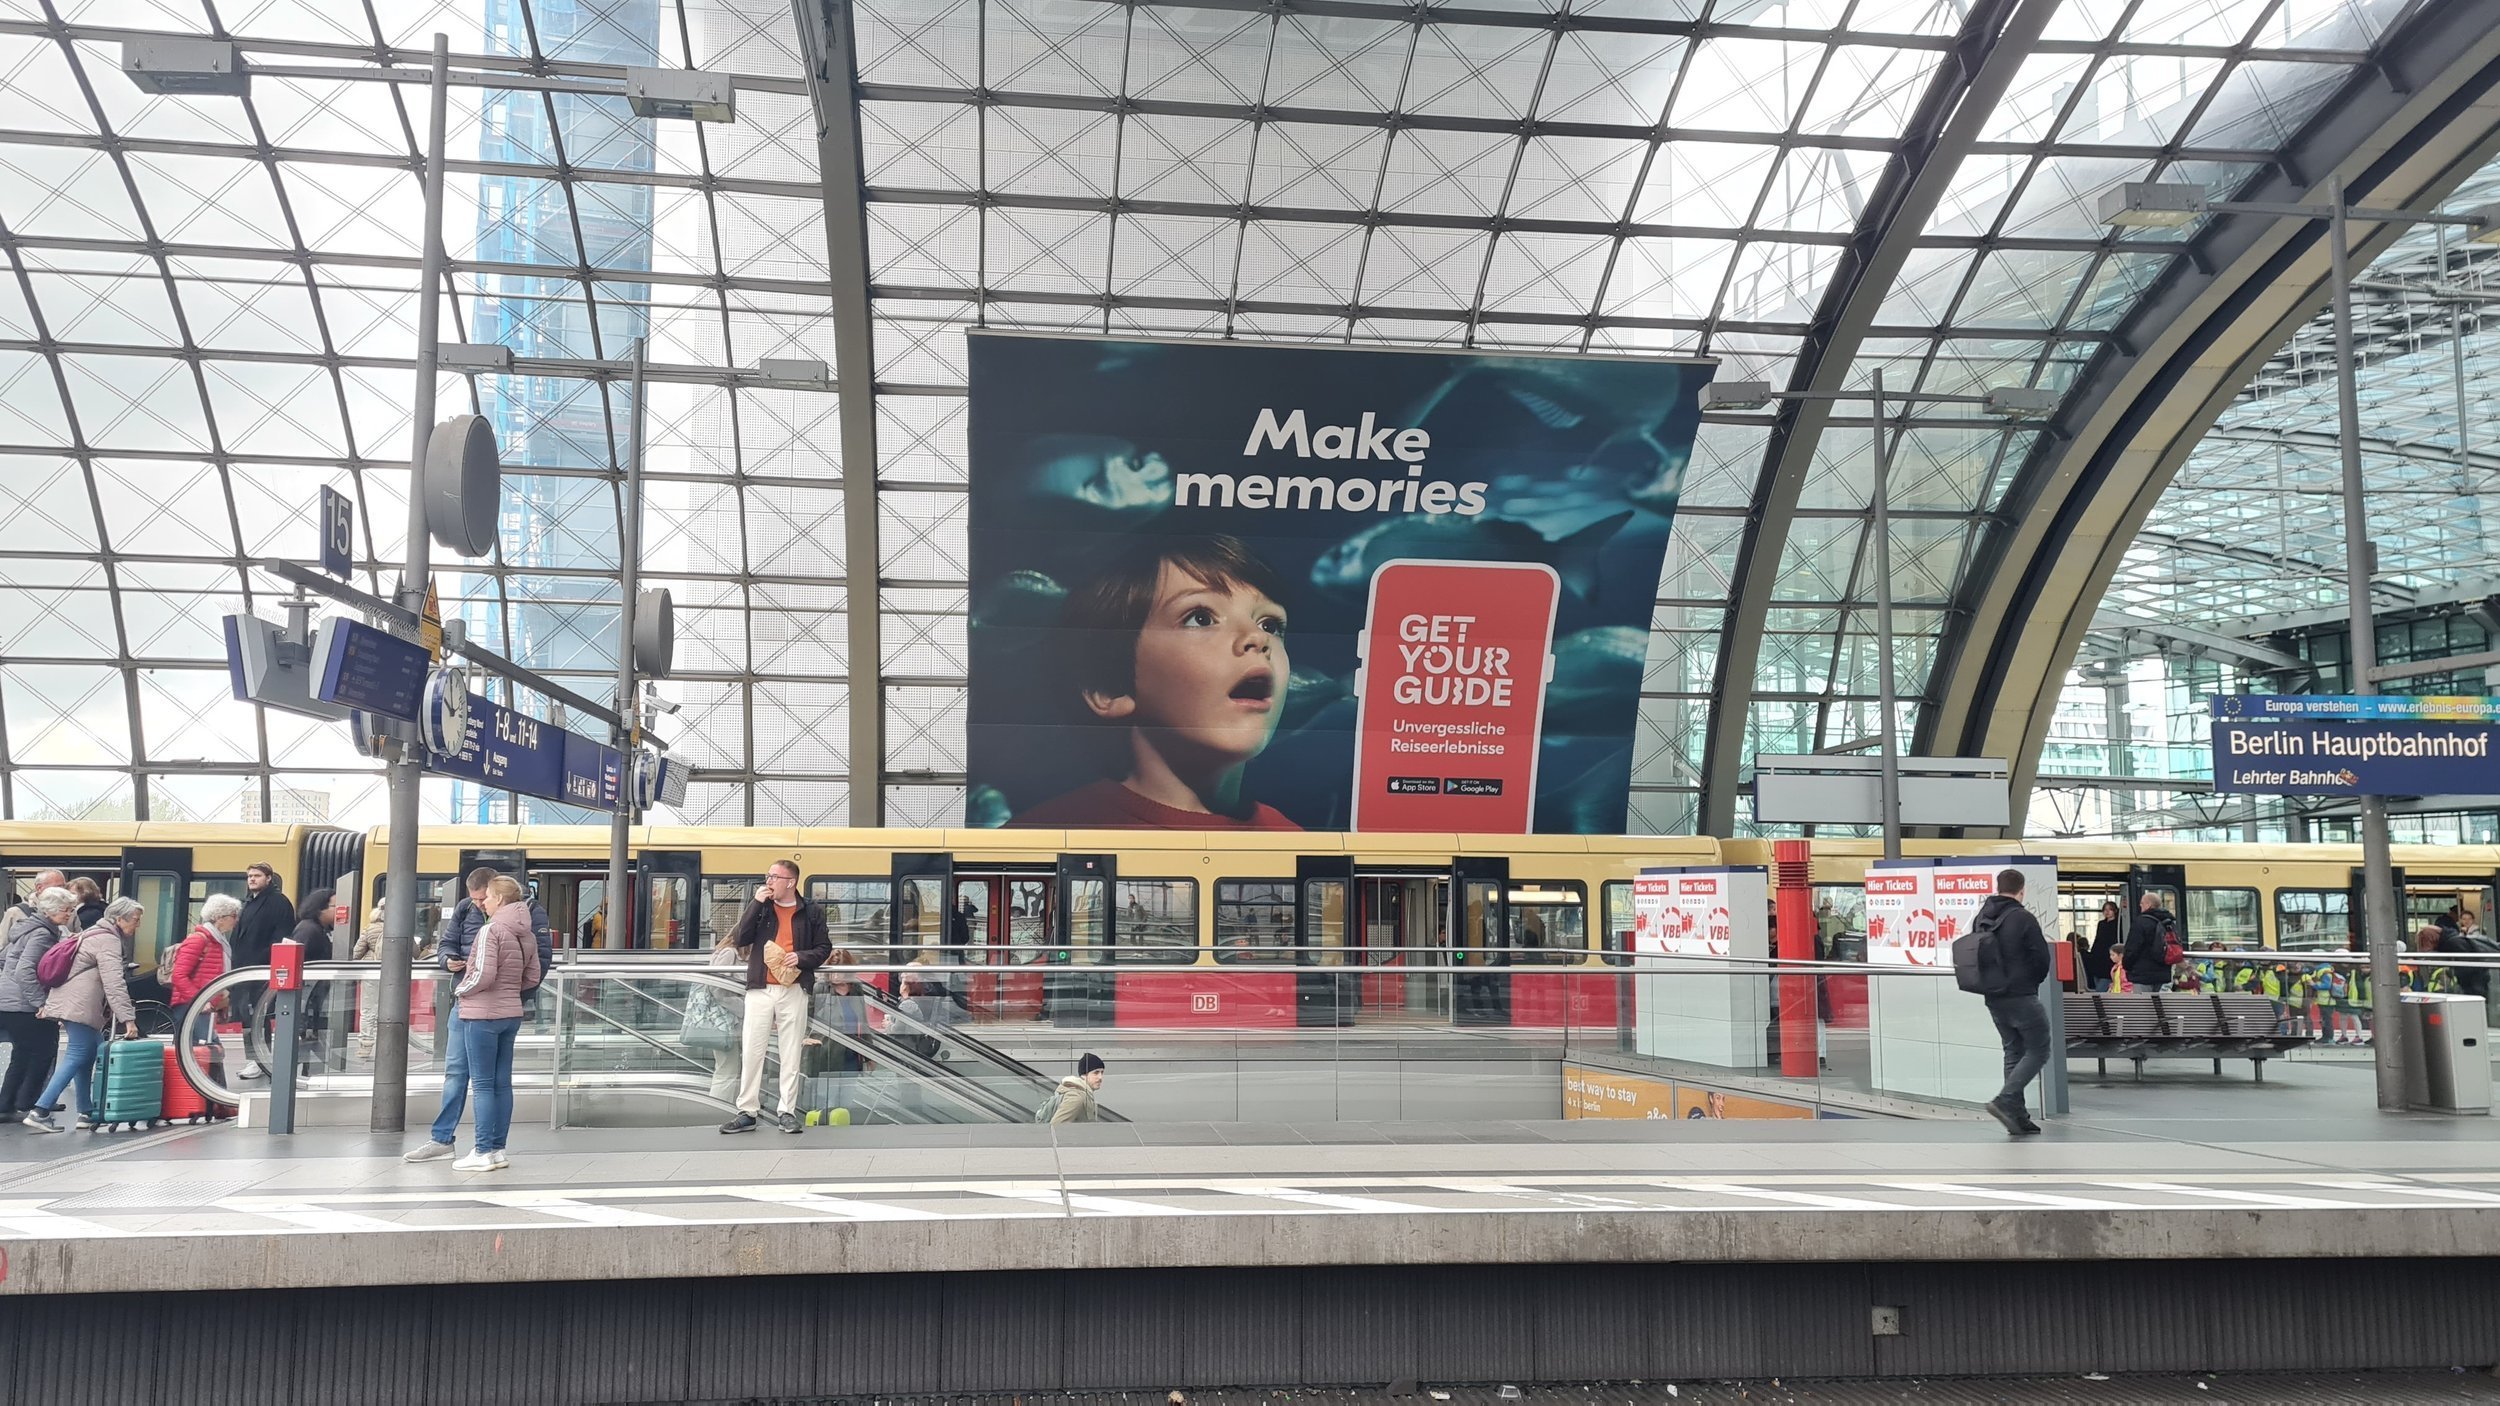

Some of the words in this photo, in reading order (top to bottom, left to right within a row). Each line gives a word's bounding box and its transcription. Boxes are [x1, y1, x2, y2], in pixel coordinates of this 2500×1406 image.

[1242, 407, 1431, 463] Make
[1174, 464, 1489, 516] memories
[327, 492, 350, 556] 15
[1399, 614, 1476, 644] GET
[1398, 644, 1510, 676] YOUR
[1393, 675, 1514, 707] GUIDE
[2265, 699, 2304, 713] Europa
[2305, 699, 2359, 713] verstehen
[495, 709, 510, 741] 1-8
[517, 716, 538, 751] 11-14
[1393, 719, 1506, 737] Unvergessliche
[1390, 738, 1505, 755] Reiseerlebnisse
[2230, 730, 2304, 756] Berlin
[2312, 730, 2488, 761] Hauptbahnhof
[2233, 769, 2286, 785] Lehrter
[1402, 784, 1417, 792] App
[1417, 784, 1436, 792] Store
[1461, 784, 1485, 794] Google
[1485, 785, 1500, 795] Play
[1635, 882, 1647, 892] Hier
[1648, 882, 1667, 893] Tickets
[1680, 882, 1693, 892] Hier
[1693, 881, 1714, 892] Tickets
[1867, 880, 1885, 892] Hier
[1886, 879, 1914, 891] Tickets
[1936, 878, 1955, 890] Hier
[1956, 877, 1988, 890] Tickets
[1195, 996, 1216, 1010] DB
[1567, 1076, 1585, 1093] best
[1586, 1083, 1605, 1100] way
[1606, 1085, 1616, 1099] to
[1617, 1088, 1638, 1106] stay
[1583, 1099, 1601, 1112] berlin
